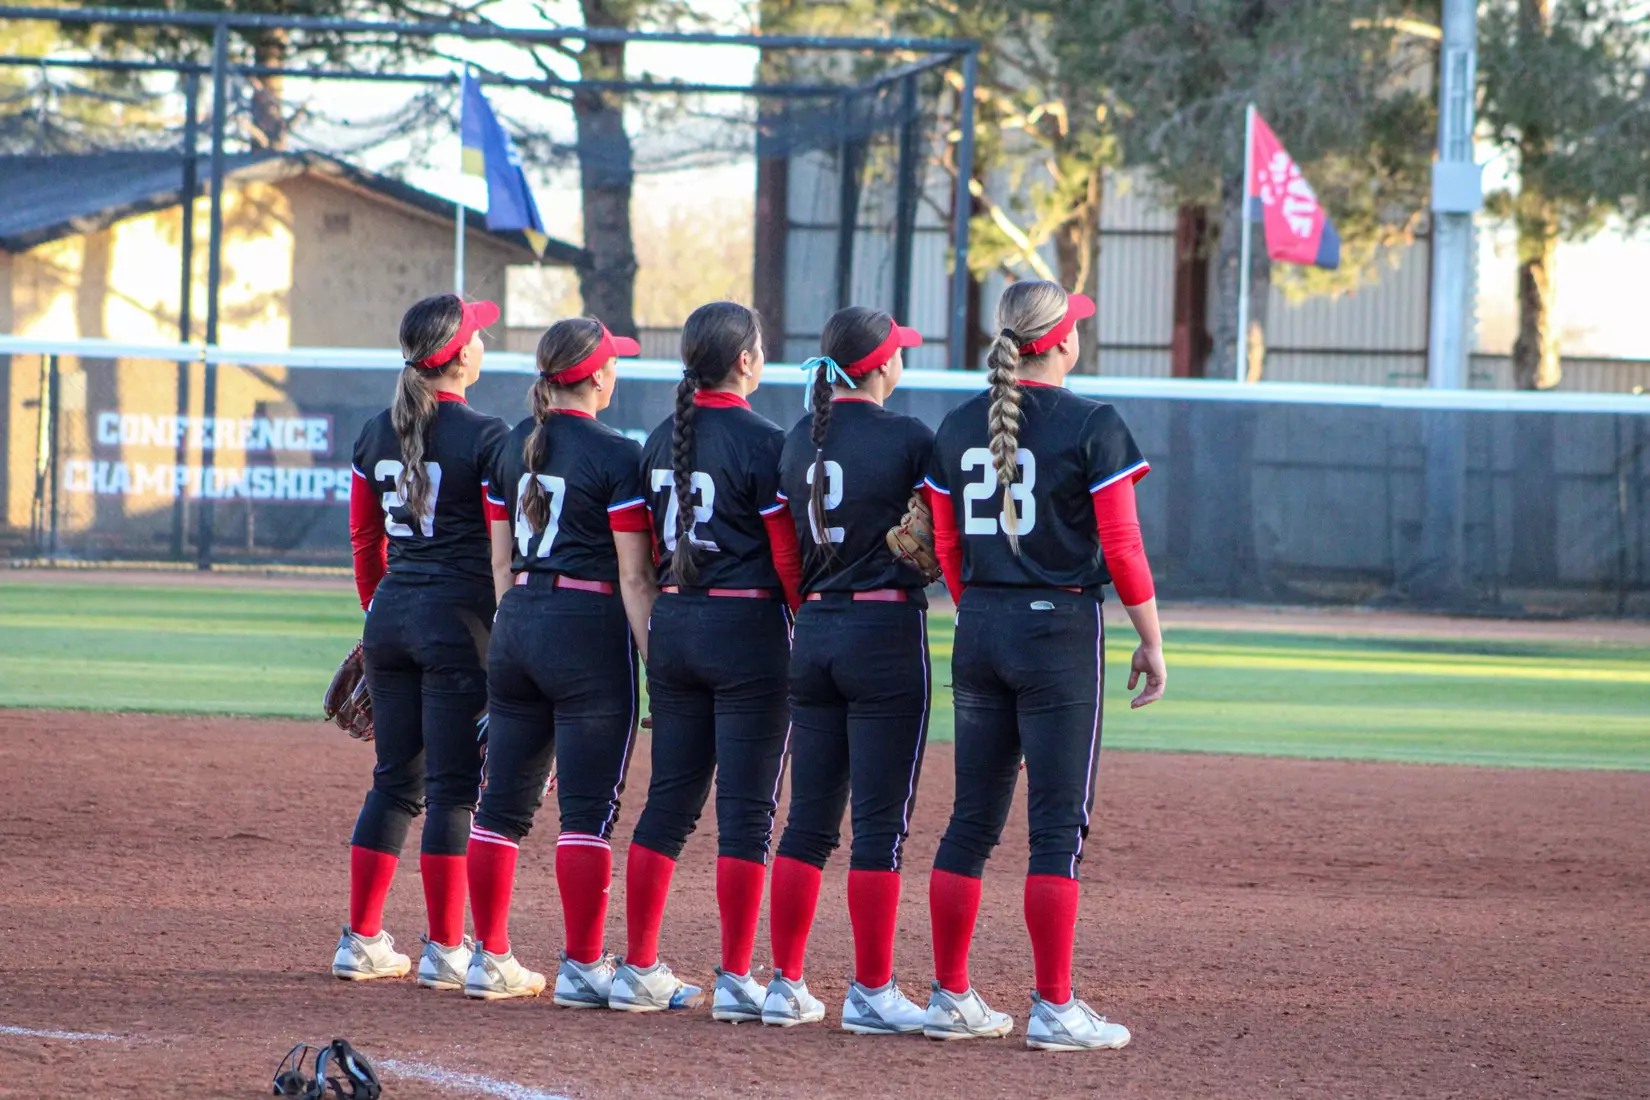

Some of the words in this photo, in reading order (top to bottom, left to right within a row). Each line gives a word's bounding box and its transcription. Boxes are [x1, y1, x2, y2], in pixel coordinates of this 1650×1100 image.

[97, 412, 330, 451] CONFERENCE
[63, 460, 352, 501] CHAMPIONSHIPS
[651, 469, 721, 552] 72
[961, 447, 1036, 536] 23
